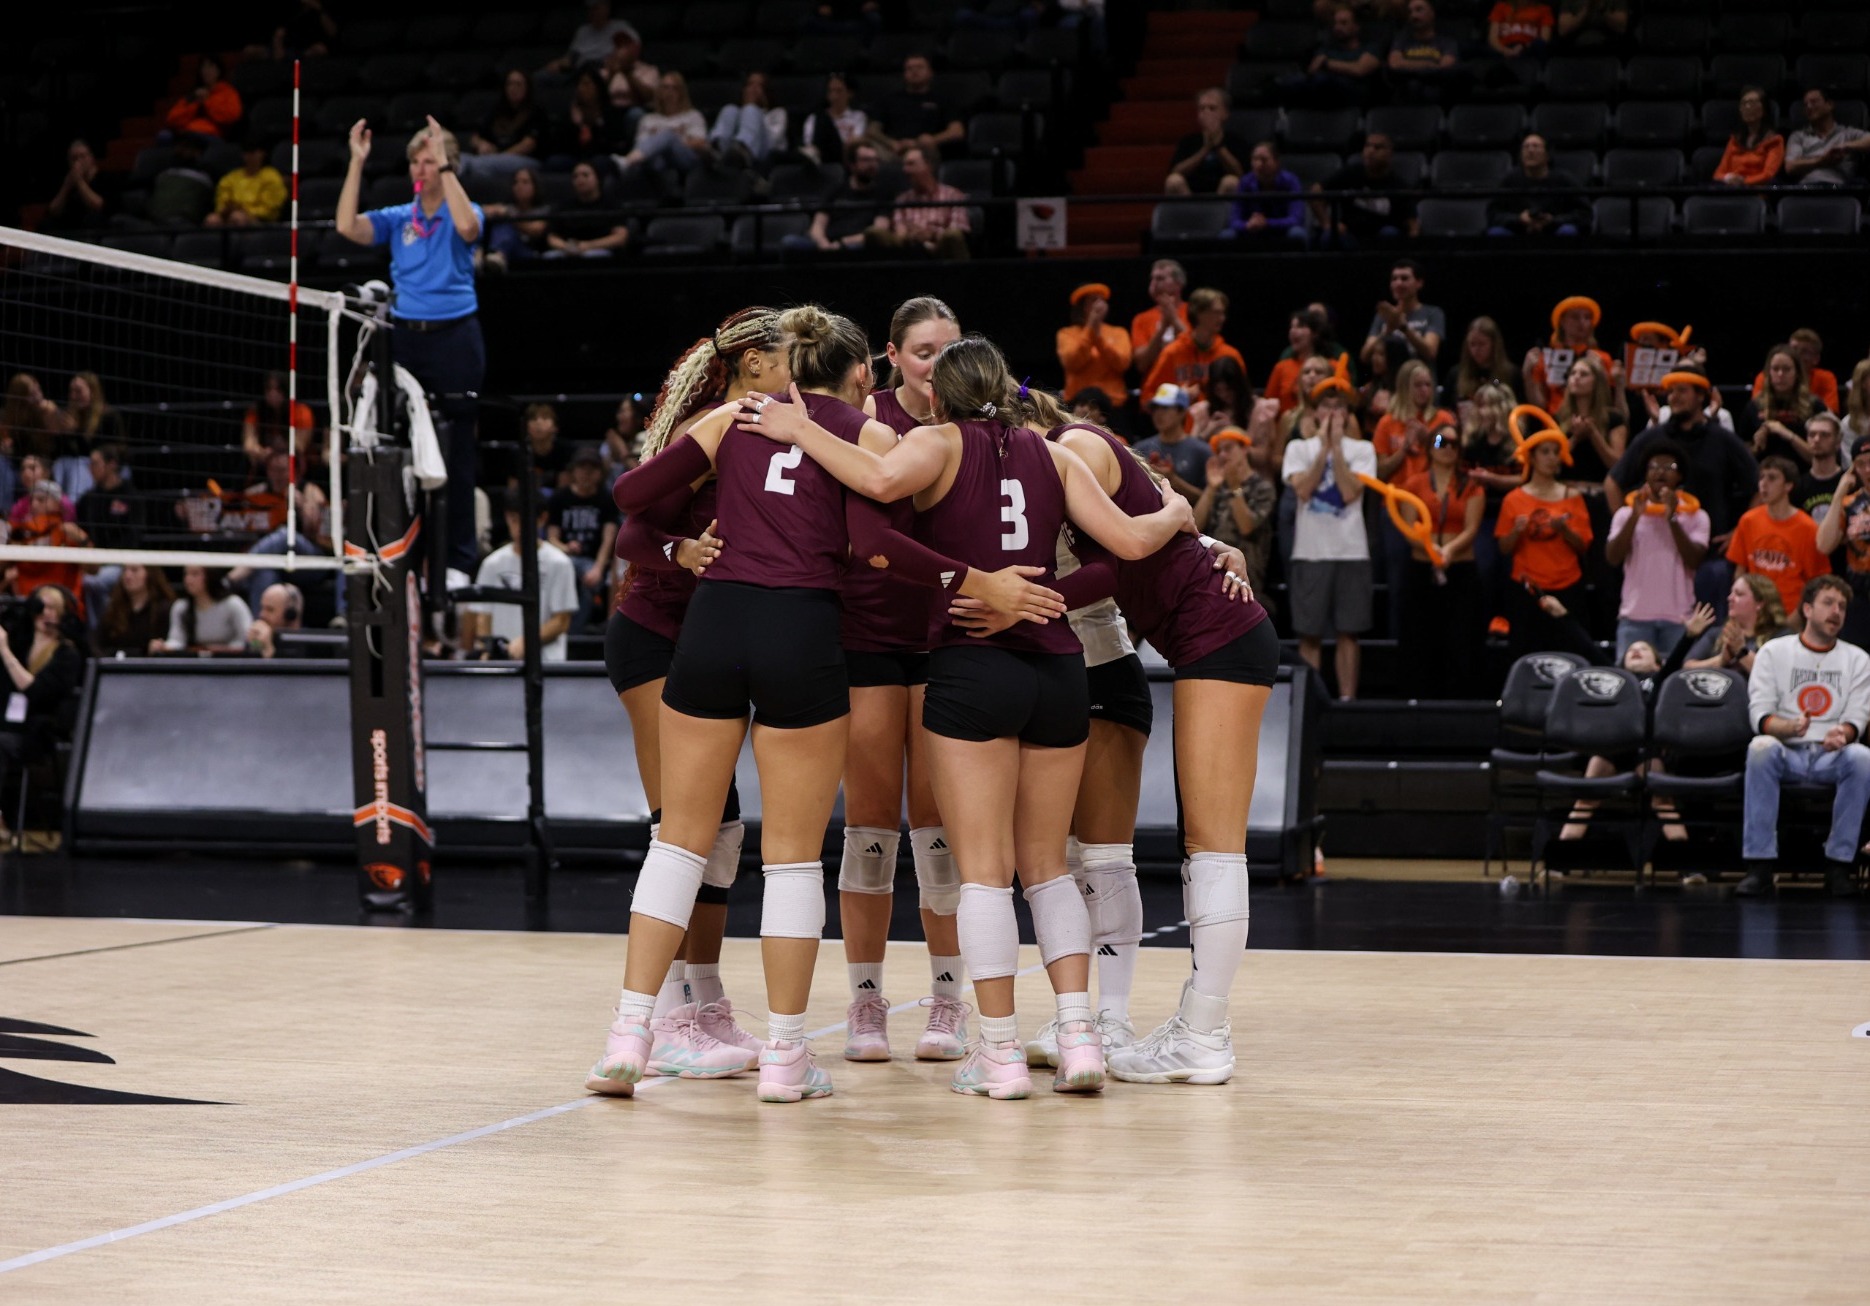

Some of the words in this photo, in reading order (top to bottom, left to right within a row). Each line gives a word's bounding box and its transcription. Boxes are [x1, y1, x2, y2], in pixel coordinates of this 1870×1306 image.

[764, 444, 804, 496] 2
[1000, 478, 1029, 551] 3
[369, 728, 389, 781] sports
[373, 781, 392, 844] imports
